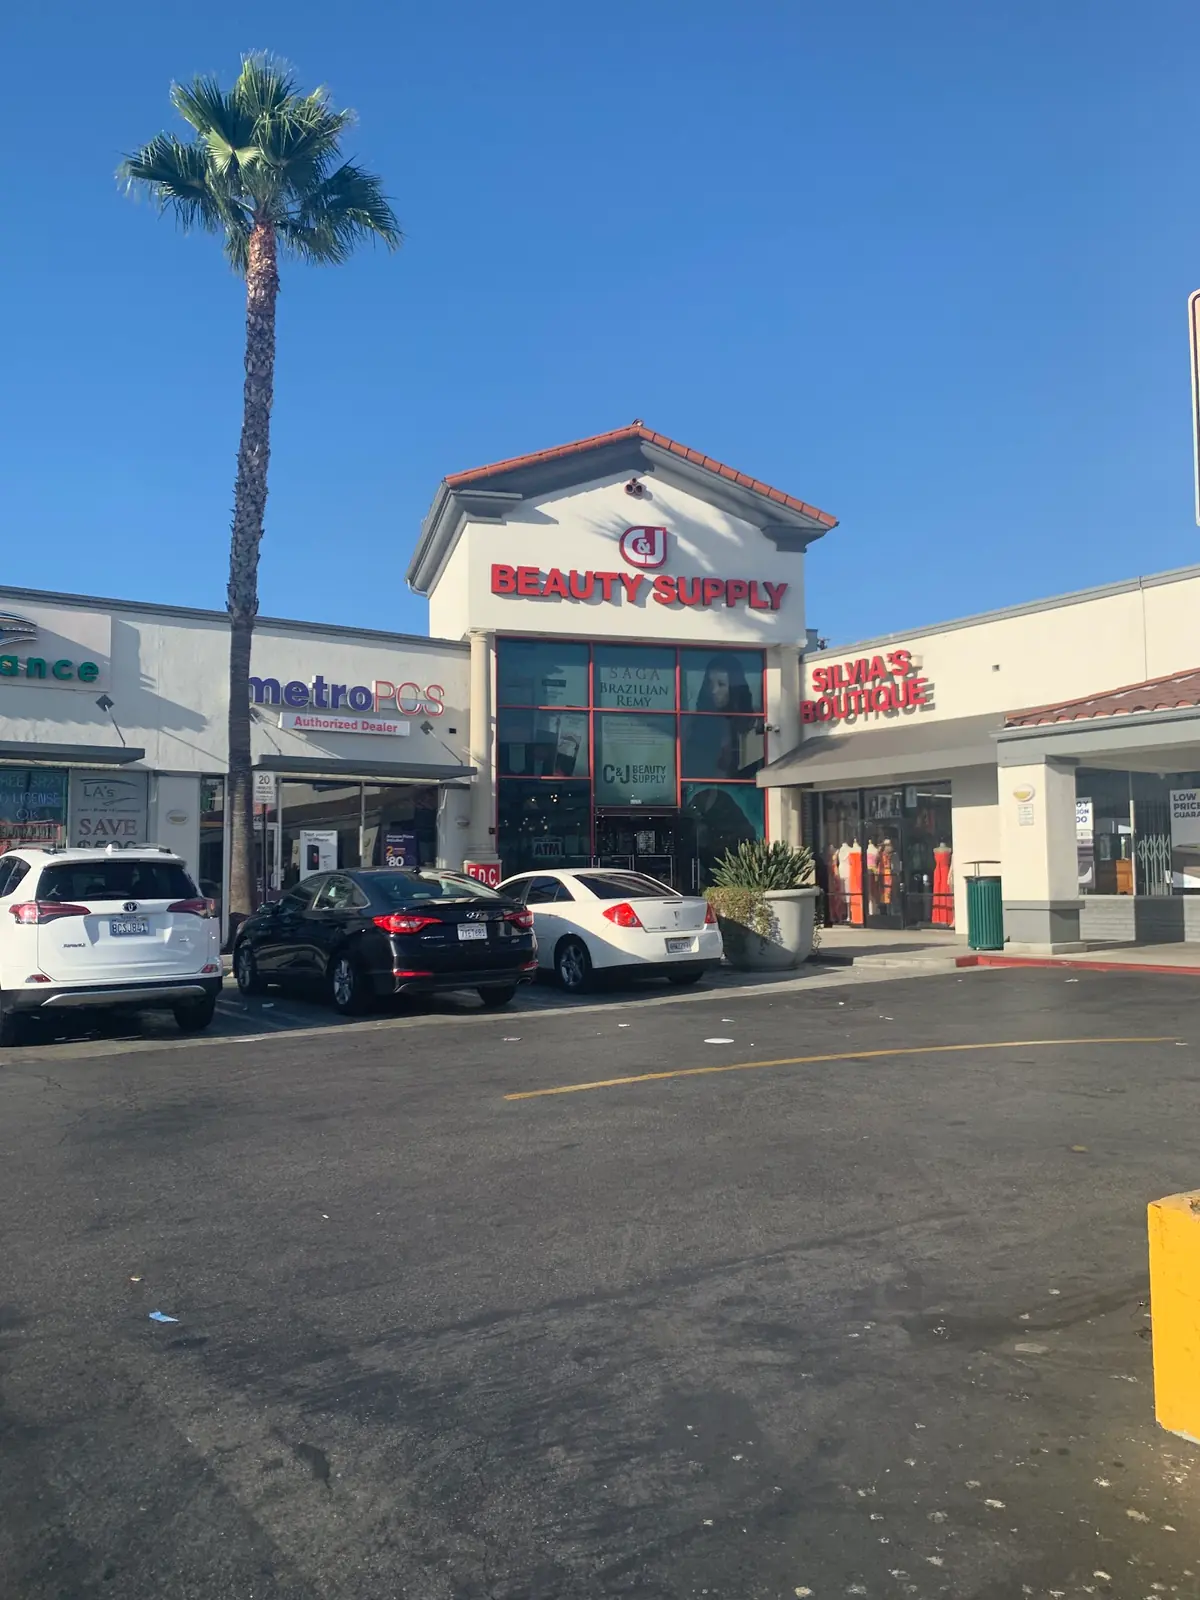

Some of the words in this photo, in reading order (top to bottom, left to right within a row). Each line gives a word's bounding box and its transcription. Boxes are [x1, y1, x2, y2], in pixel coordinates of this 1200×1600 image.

[491, 564, 644, 602] BEAUTY
[652, 575, 788, 610] SUPPLY
[0, 655, 99, 682] ance
[609, 667, 660, 681] SAGA
[812, 650, 912, 693] SILVIA'S
[249, 674, 445, 717] metroPCS
[600, 682, 669, 696] BRAZILIAN
[616, 694, 651, 707] REMY
[800, 677, 928, 724] BOUTIQUE
[294, 716, 358, 730] Authorized
[361, 722, 398, 733] Dealer
[603, 764, 630, 784] C&J
[632, 765, 666, 774] BEAUTY
[258, 774, 271, 785] 20
[632, 775, 666, 784] SUPPLY
[13, 792, 59, 804] LICENSE
[84, 785, 116, 798] LA's
[1173, 793, 1197, 802] LOW
[16, 808, 39, 820] OK
[79, 818, 138, 836] SAVE
[386, 846, 393, 856] 2
[535, 843, 560, 856] ATM
[386, 856, 404, 867] $80
